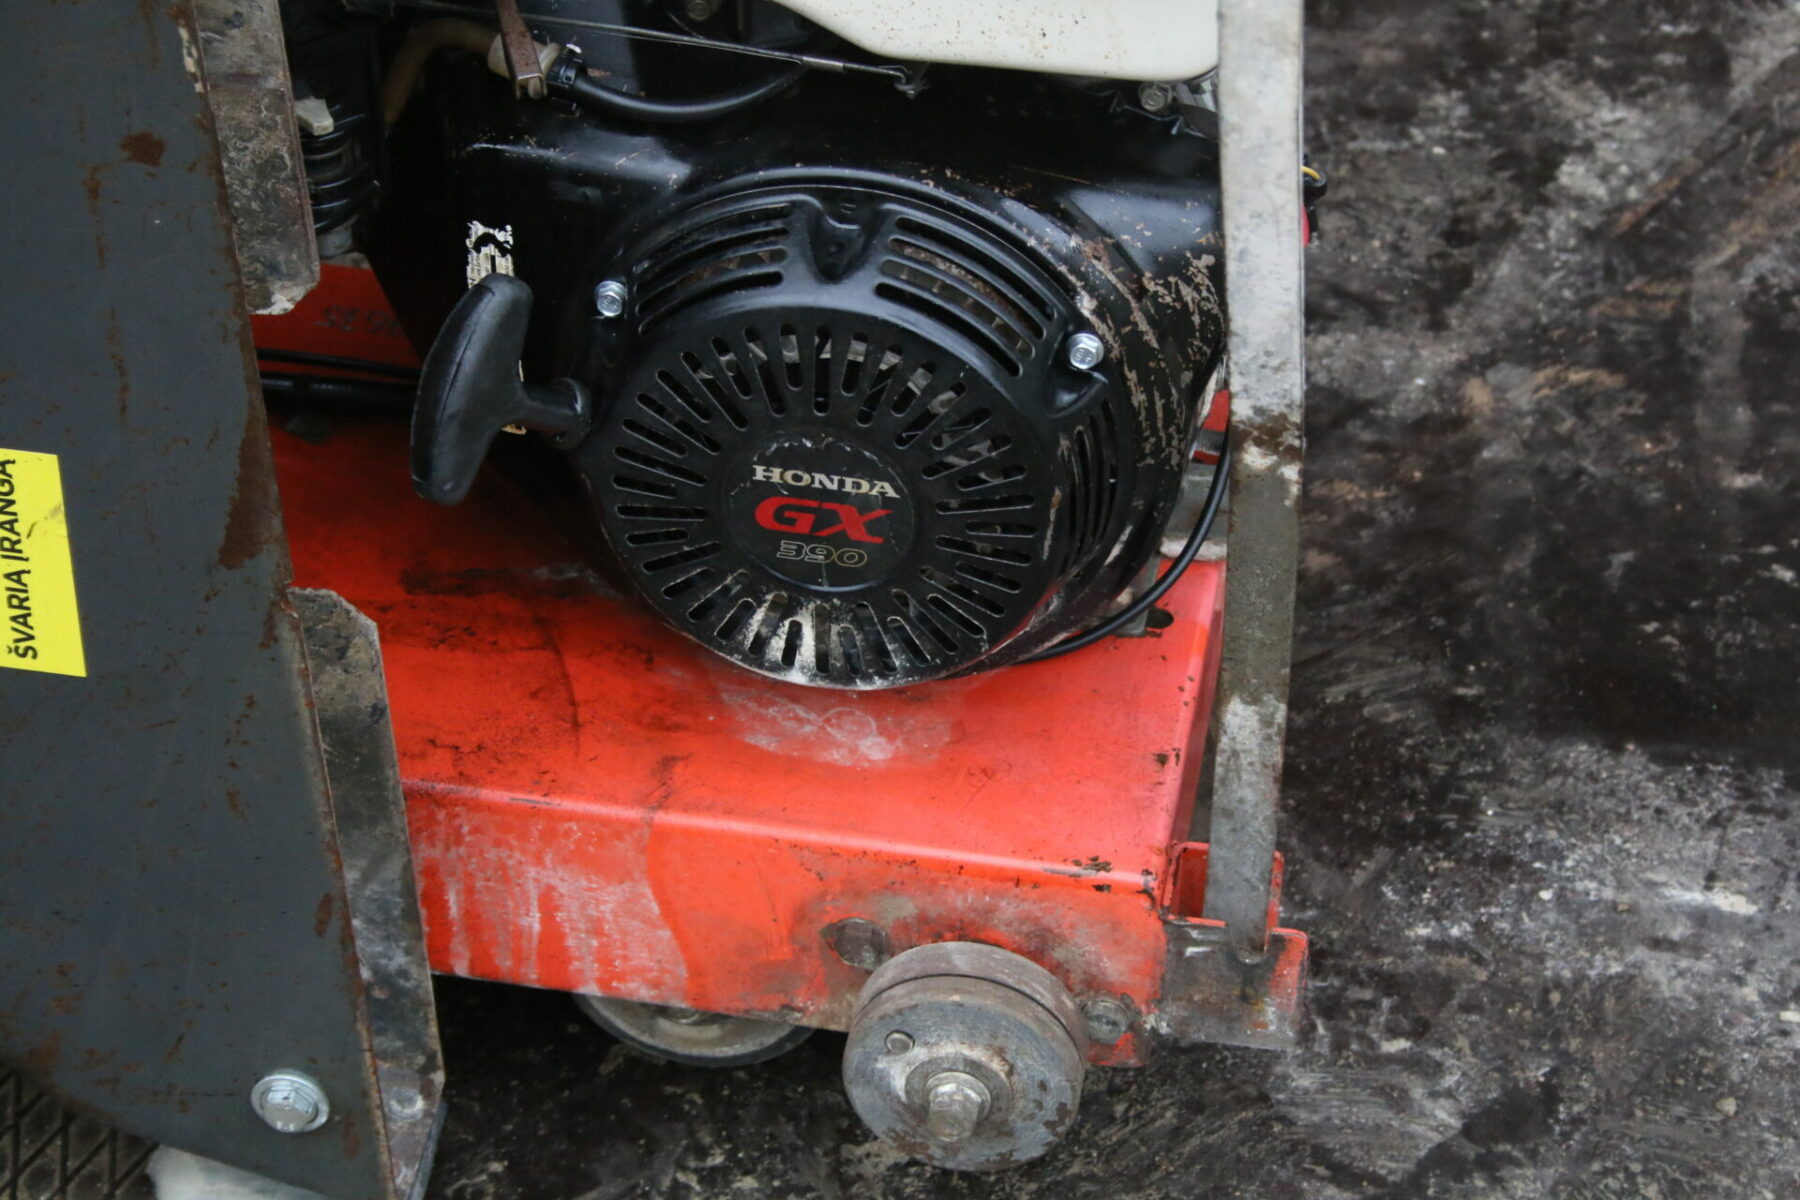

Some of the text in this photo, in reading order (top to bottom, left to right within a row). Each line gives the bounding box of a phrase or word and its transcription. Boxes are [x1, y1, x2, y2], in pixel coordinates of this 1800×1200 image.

[752, 464, 900, 499] HONDA
[754, 496, 893, 545] GX
[776, 540, 868, 568] 390
[3, 569, 38, 660] ŠVARIĄ
